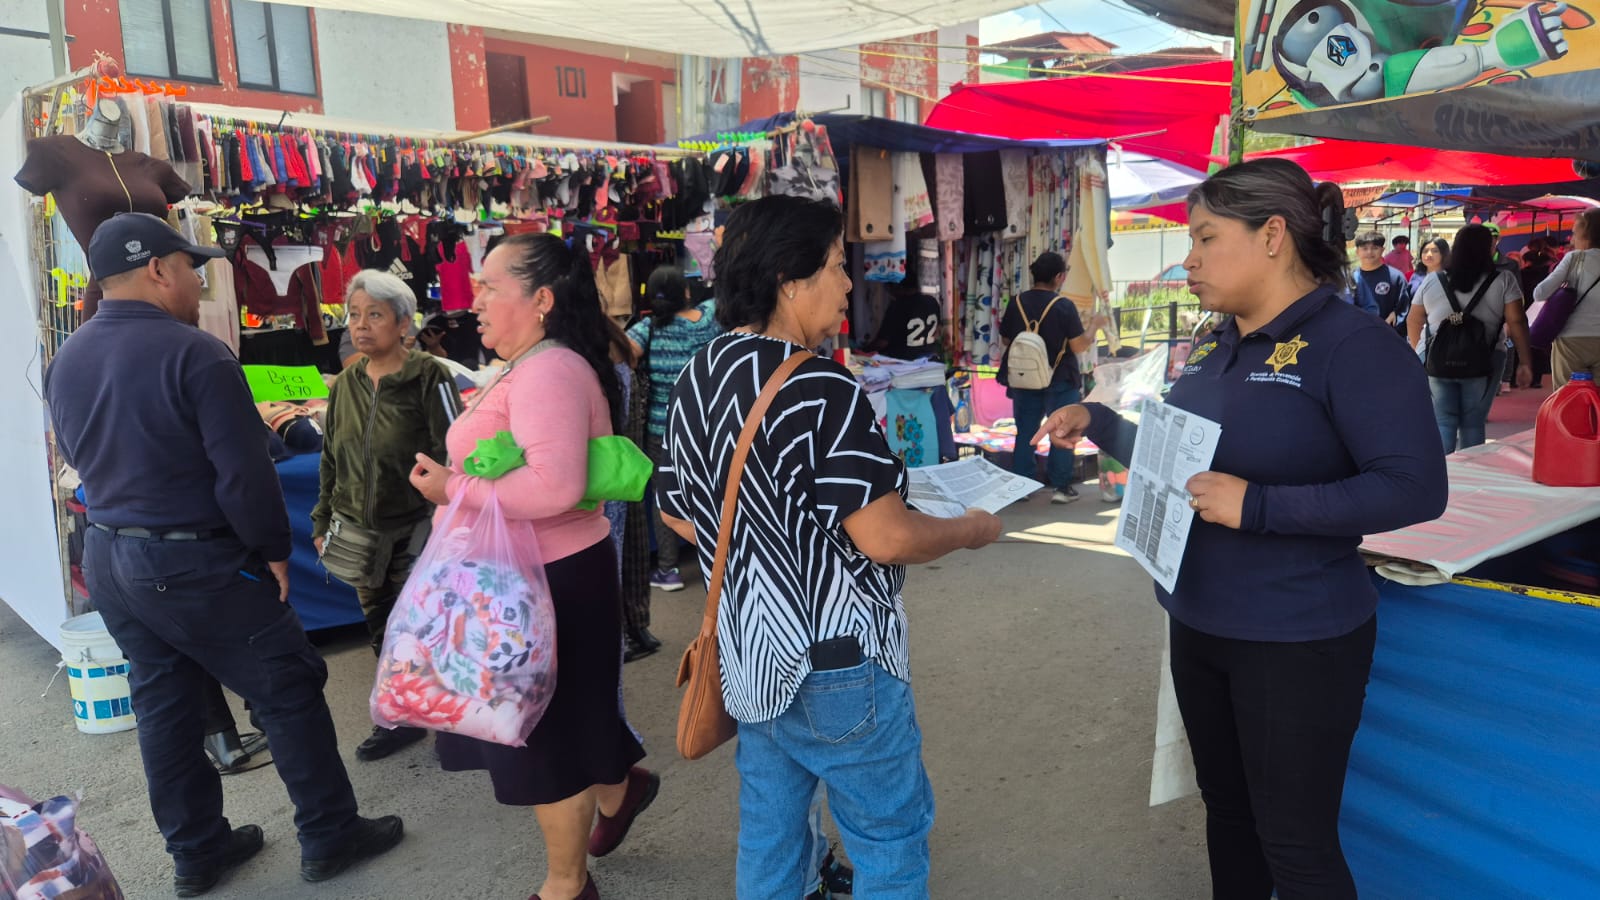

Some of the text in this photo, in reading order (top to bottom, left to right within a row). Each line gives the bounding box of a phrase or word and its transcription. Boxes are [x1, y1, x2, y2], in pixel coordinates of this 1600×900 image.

[554, 65, 587, 99] 101
[906, 314, 938, 347] 22
[267, 370, 304, 385] Bra
[284, 384, 312, 398] $70
